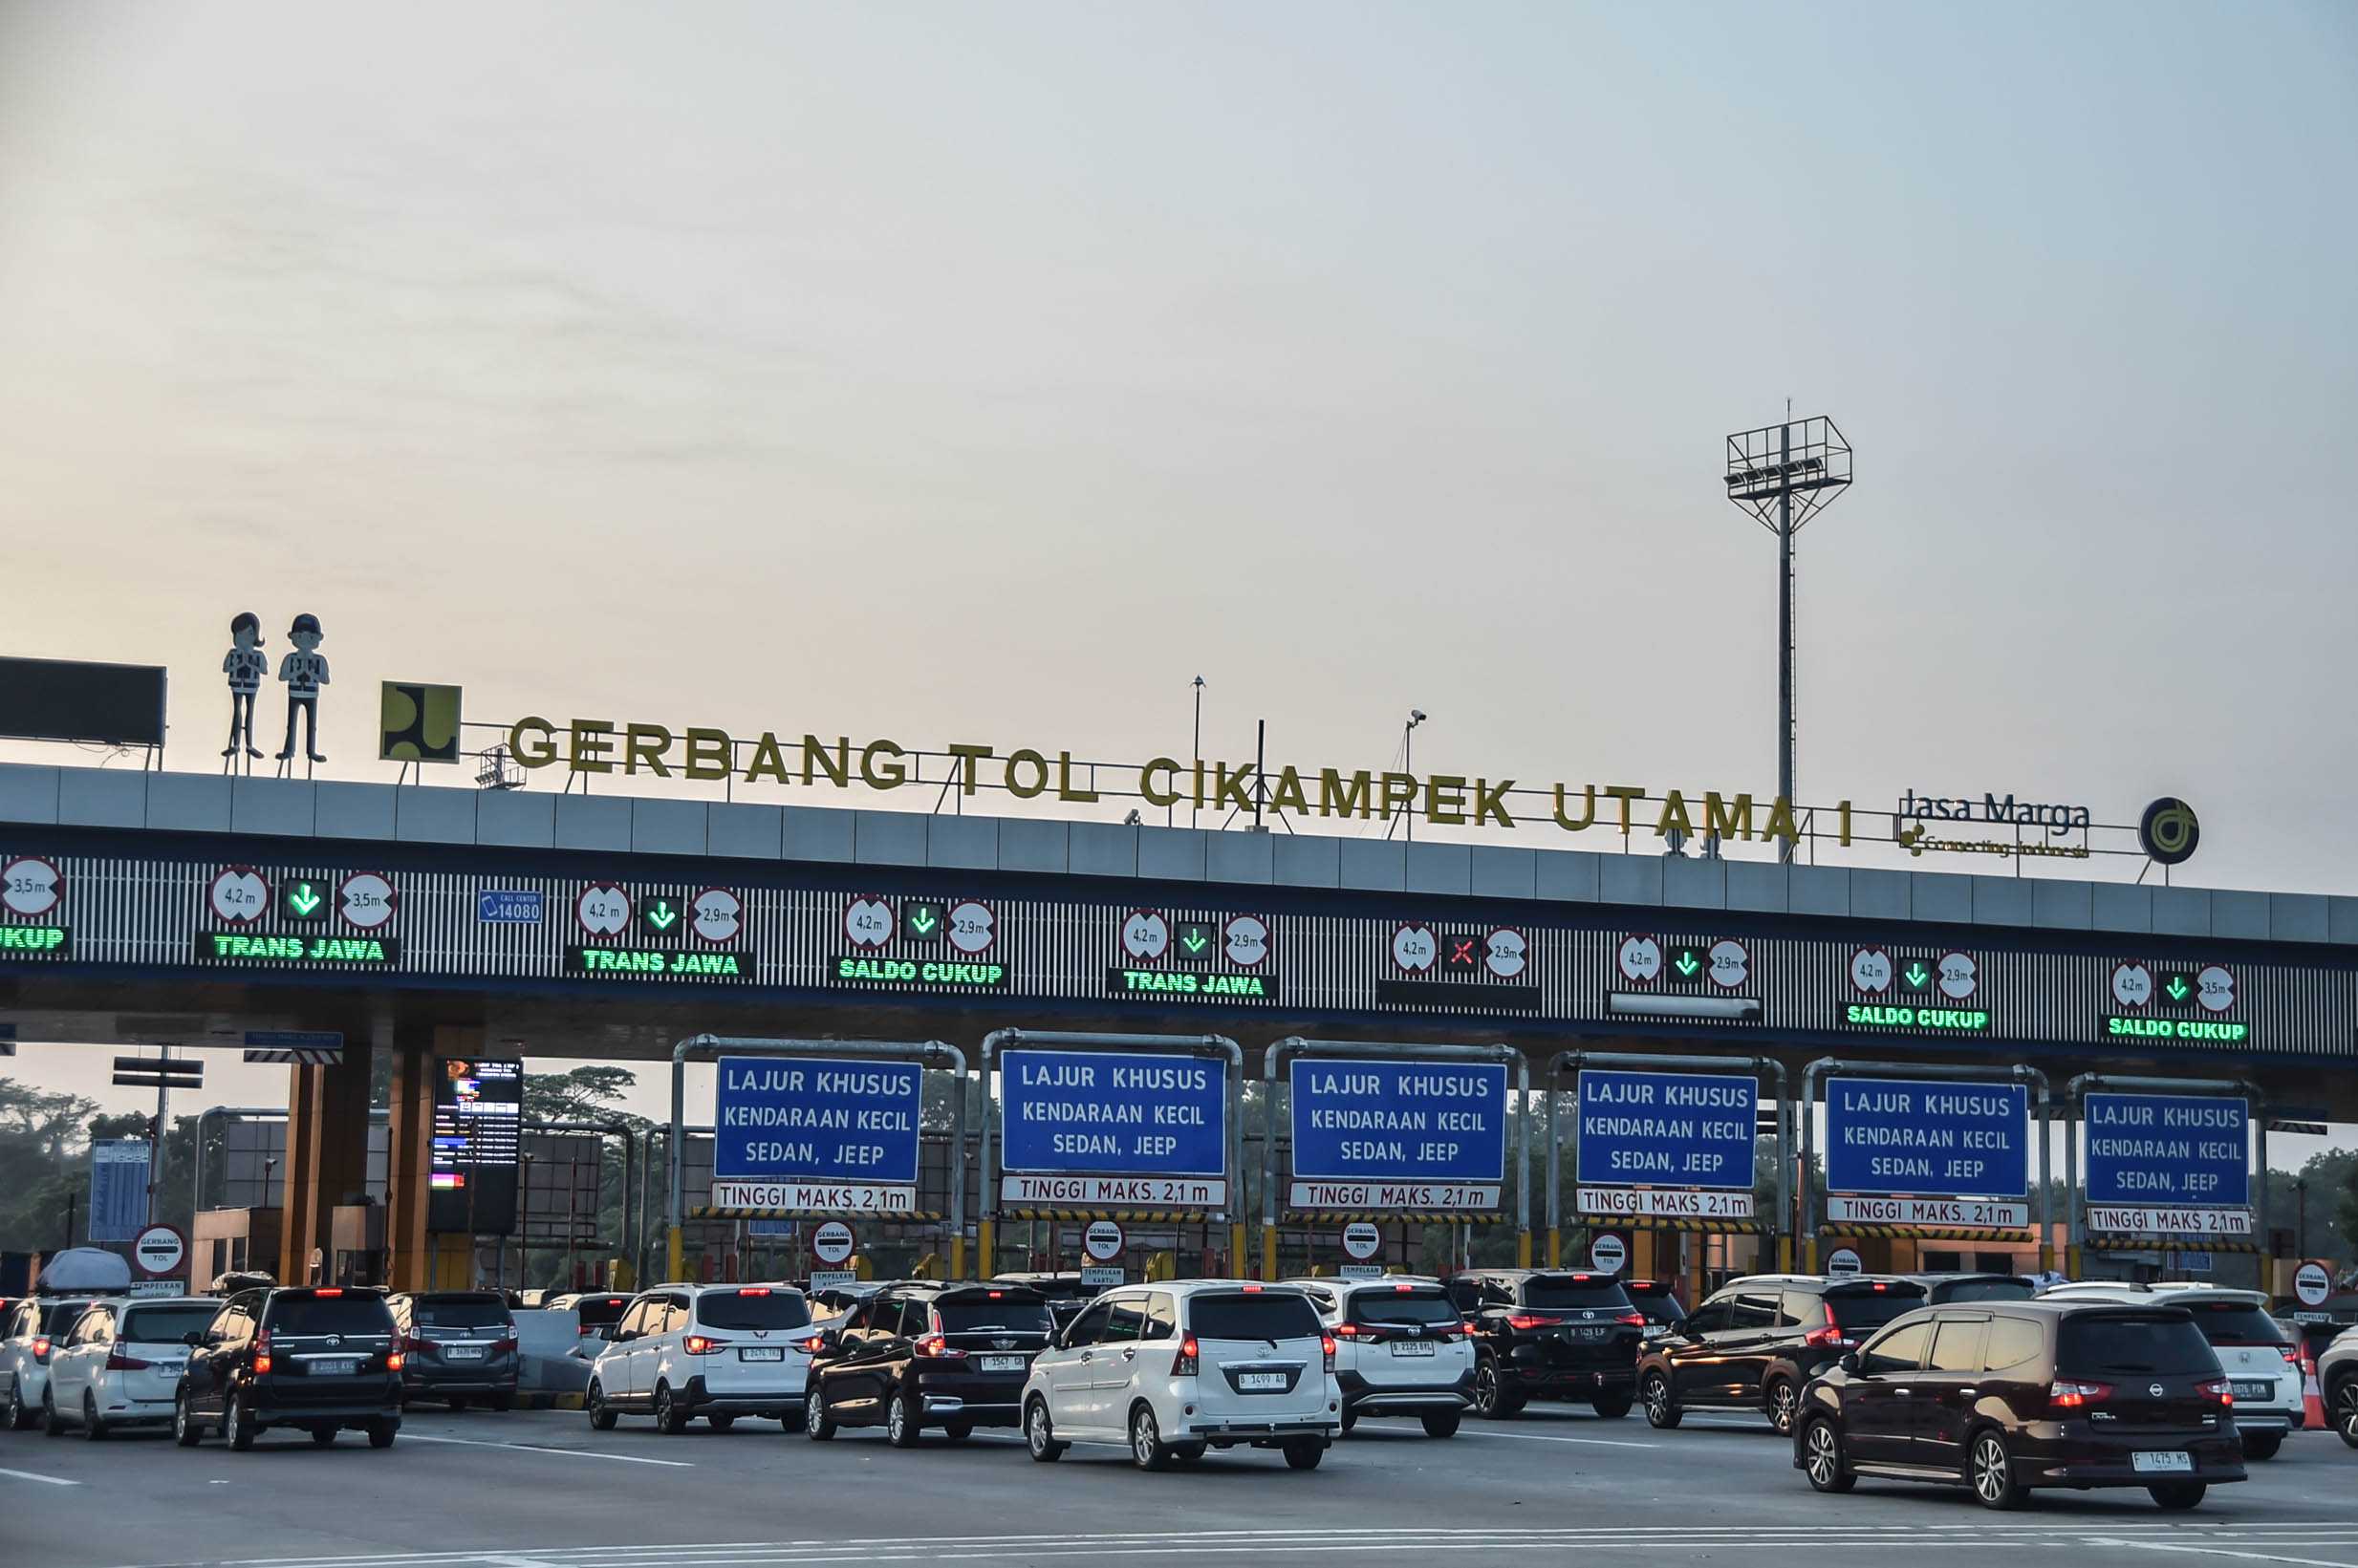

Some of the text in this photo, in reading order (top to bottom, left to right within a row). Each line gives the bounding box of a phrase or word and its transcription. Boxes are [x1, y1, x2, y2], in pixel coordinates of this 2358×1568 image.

[510, 716, 906, 790] GERBANG
[948, 743, 1099, 803] TOL
[1139, 757, 1516, 827] CIKAMPEK
[1552, 783, 1800, 845] UTAMA
[1901, 788, 2089, 836] Jasa Marga
[14, 879, 32, 894] 3,5
[225, 888, 255, 904] 4,2 m
[501, 893, 537, 904] CALL CENTER
[498, 904, 540, 919] 14080
[589, 902, 619, 918] 4,2 m
[0, 927, 64, 949] KUP
[214, 935, 384, 960] TRANS JAWA
[583, 950, 739, 974] TRANS JAWA
[839, 958, 1003, 983] SALDO CUKUP
[1123, 971, 1264, 995] TRANS JAWA
[1847, 1005, 1986, 1028] SALDO CUKUP
[2109, 1018, 2244, 1040] SALDO CUKUP
[727, 1068, 912, 1096] LAJUR KHUSUS
[1022, 1064, 1206, 1090] LAJUR KHUSUS
[1311, 1073, 1488, 1097] LAJUR KHUSUS
[1587, 1083, 1748, 1107] LAJUR KHUSUS
[1844, 1092, 2010, 1116] LAJUR KHUSUS
[725, 1106, 911, 1131] KENDARAAN KECIL
[1023, 1102, 1205, 1125] KENDARAAN KECIL
[1311, 1109, 1485, 1131] KENDARAAN KECIL
[2092, 1106, 2240, 1128] LAJUR KHUSUS
[1585, 1117, 1748, 1140] KENDARAAN KECIL
[1845, 1127, 2010, 1149] KENDARAAN KECIL
[746, 1142, 884, 1166] SEDAN, JEEP
[1053, 1134, 1177, 1156] SEDAN, JEEP
[1341, 1142, 1459, 1162] SEDAN, JEEP
[2091, 1138, 2241, 1160] KENDARAAN KECIL
[1611, 1150, 1723, 1173] SEDAN, JEEP
[1871, 1157, 1983, 1178] SEDAN, JEEP
[1021, 1180, 1087, 1199] TINGGI
[1097, 1182, 1156, 1201] MAKS.
[2116, 1171, 2218, 1192] SEDAN, JEEP
[720, 1187, 786, 1206] TINGGI
[797, 1189, 856, 1209] MAKS.
[1308, 1186, 1369, 1204] TINGGI
[1380, 1188, 1434, 1206] MAKS.
[1584, 1192, 1643, 1211] TINGGI
[1652, 1193, 1700, 1213] MAKS
[1844, 1200, 1902, 1219] TINGGI
[1912, 1203, 1965, 1222] MAKS.
[2093, 1211, 2149, 1229] TINGGI
[2156, 1212, 2202, 1230] MAKS
[993, 1357, 1009, 1366] 1547
[1240, 1374, 1286, 1385] B 1499 AR
[2134, 1453, 2140, 1464] F
[2151, 1452, 2172, 1465] 1475
